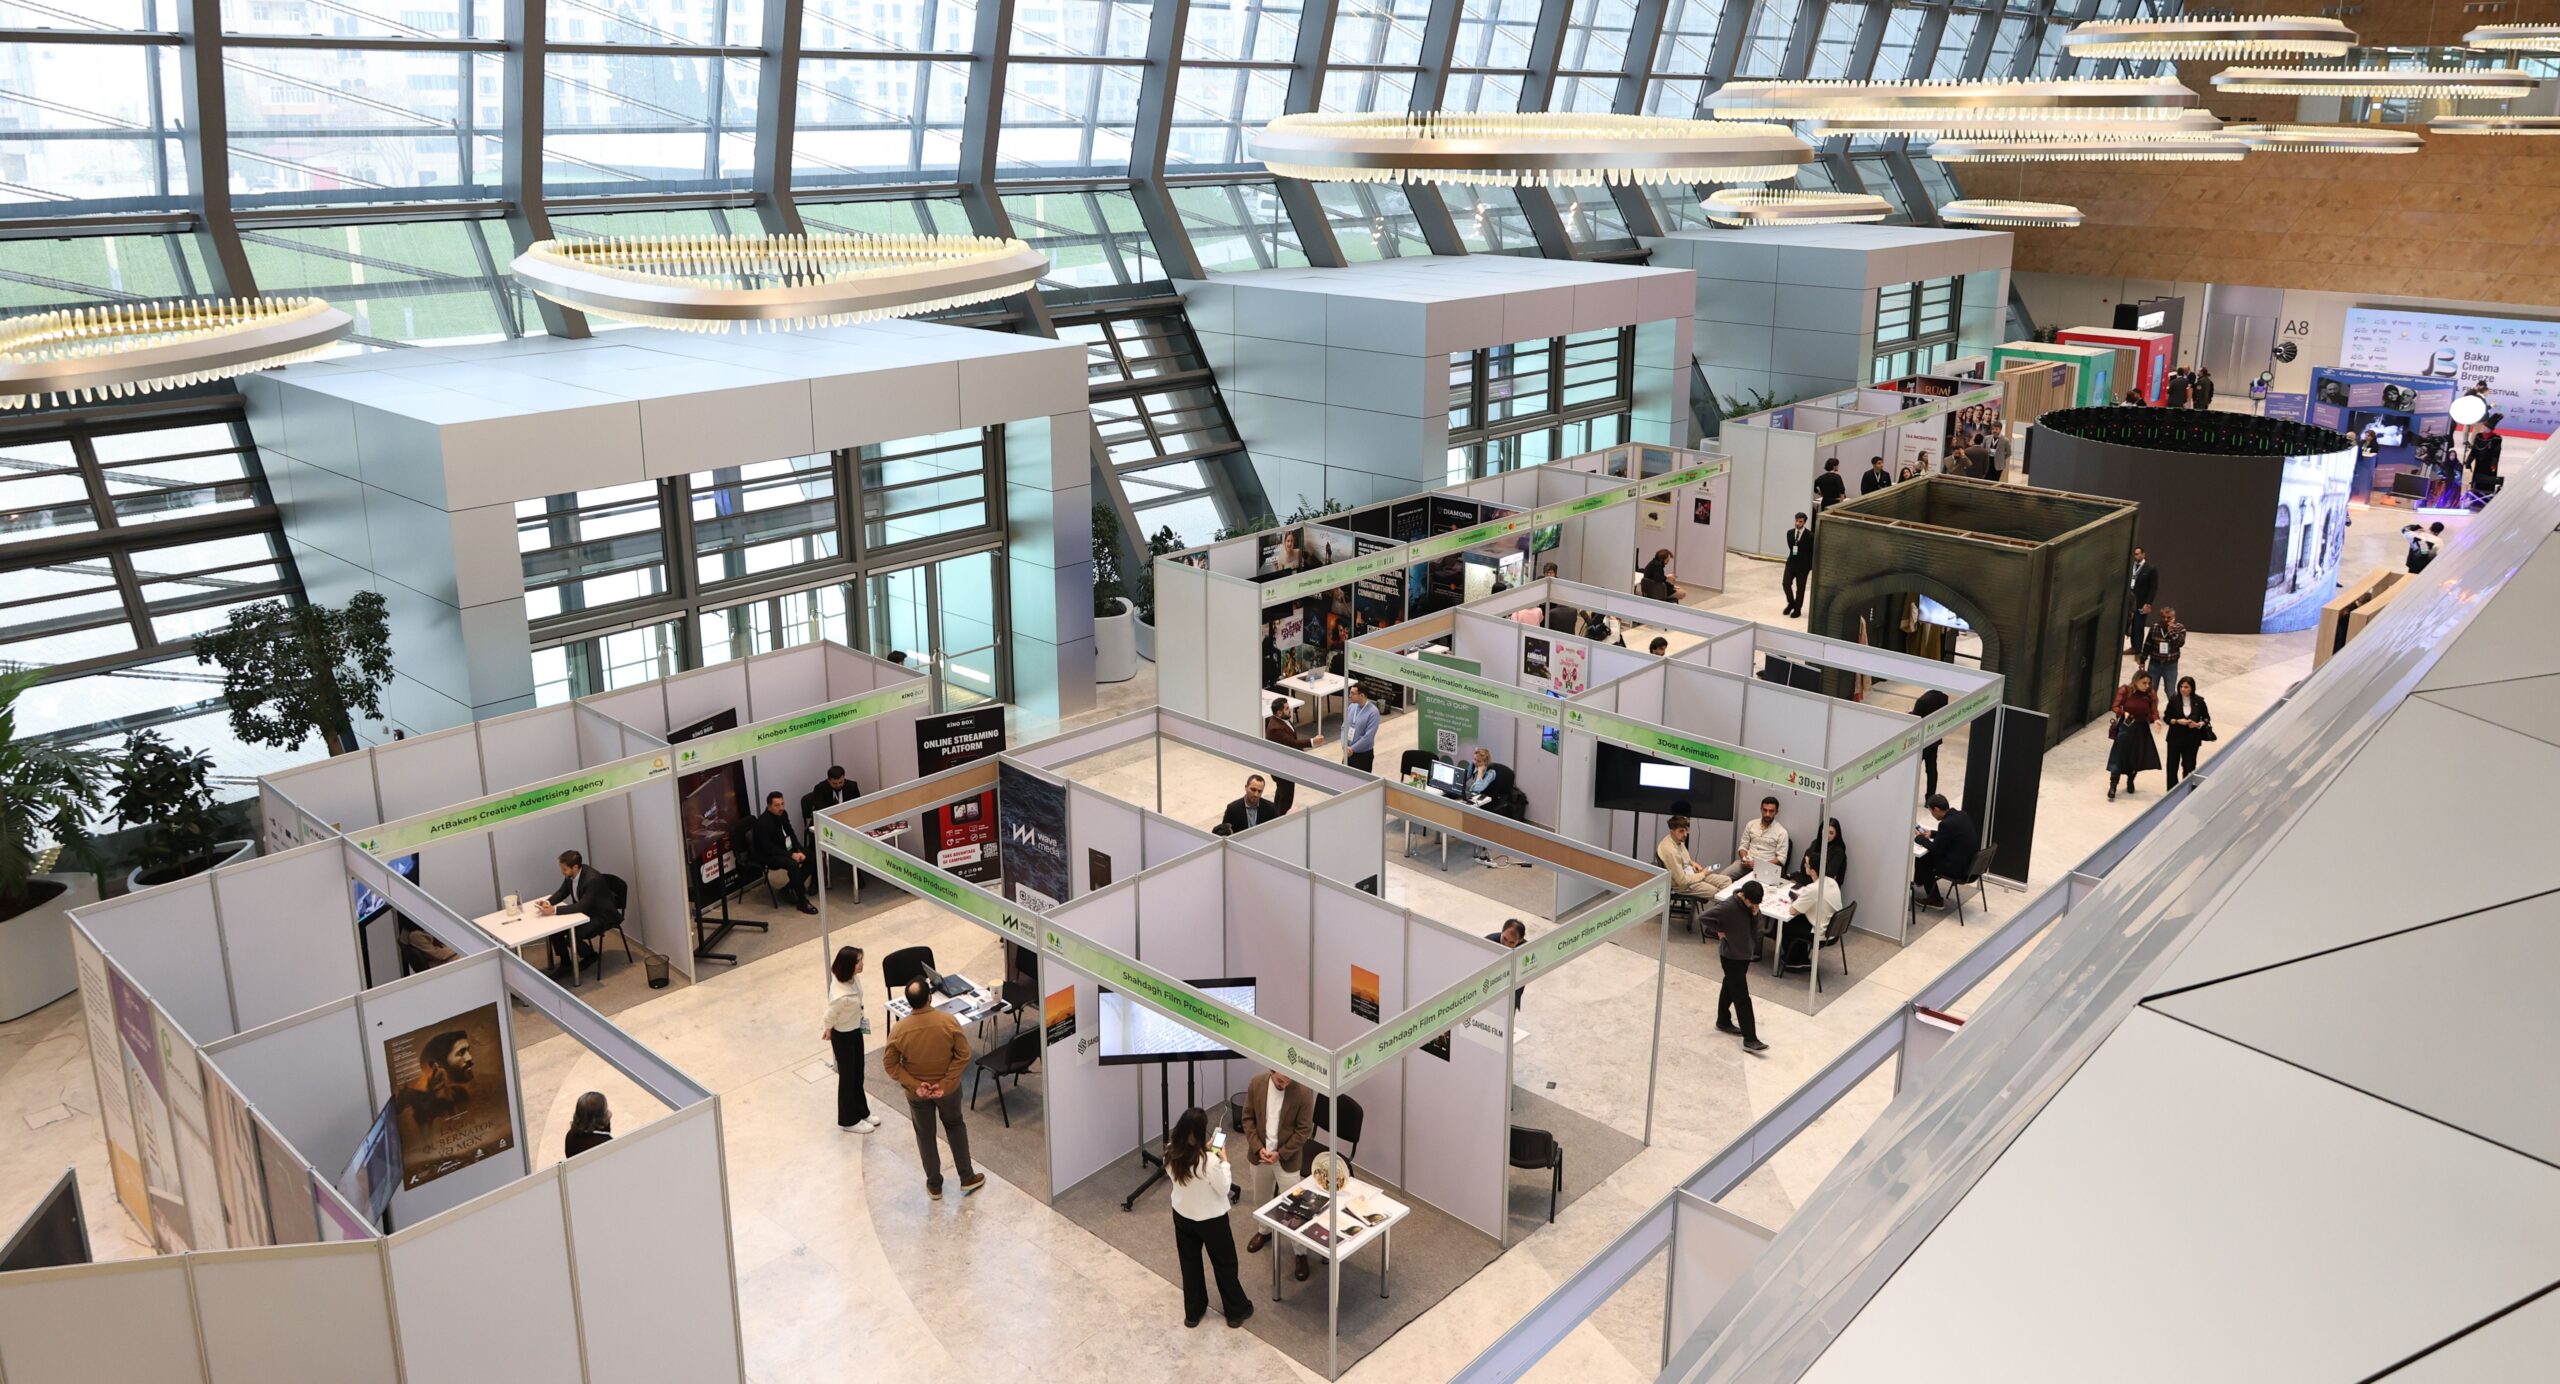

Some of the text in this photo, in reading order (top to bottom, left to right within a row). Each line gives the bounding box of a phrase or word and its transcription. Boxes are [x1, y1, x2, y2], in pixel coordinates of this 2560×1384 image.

[2284, 320, 2309, 335] A8
[2464, 352, 2489, 362] Baku
[2462, 362, 2500, 373] Cinema
[2460, 372, 2494, 382] Breeze
[2488, 388, 2520, 396] ESTIVAL
[1444, 508, 1472, 519] DIAMOND
[1400, 666, 1500, 700] Azerbaijan Animation Association
[1527, 701, 1558, 716] anima
[758, 708, 858, 741] Kinobox Streaming Platform
[961, 718, 973, 726] BOX
[924, 729, 999, 749] ONLINE STREAMING
[941, 742, 983, 756] PLATFORM
[1657, 738, 1719, 760] 3Dost Animation
[1798, 775, 1825, 791] 3Dost
[430, 778, 604, 834] ArtBakers Creative Advertising Agency
[1038, 832, 1057, 846] wave
[1038, 842, 1060, 857] media
[886, 859, 958, 899] Wave Media Production
[1557, 906, 1632, 950] Chinar Film Production
[1122, 971, 1162, 997] Shahdagh
[1164, 990, 1182, 1005] Film
[1184, 1000, 1230, 1028] Production
[1378, 989, 1477, 1052] Shahdagh Film Production
